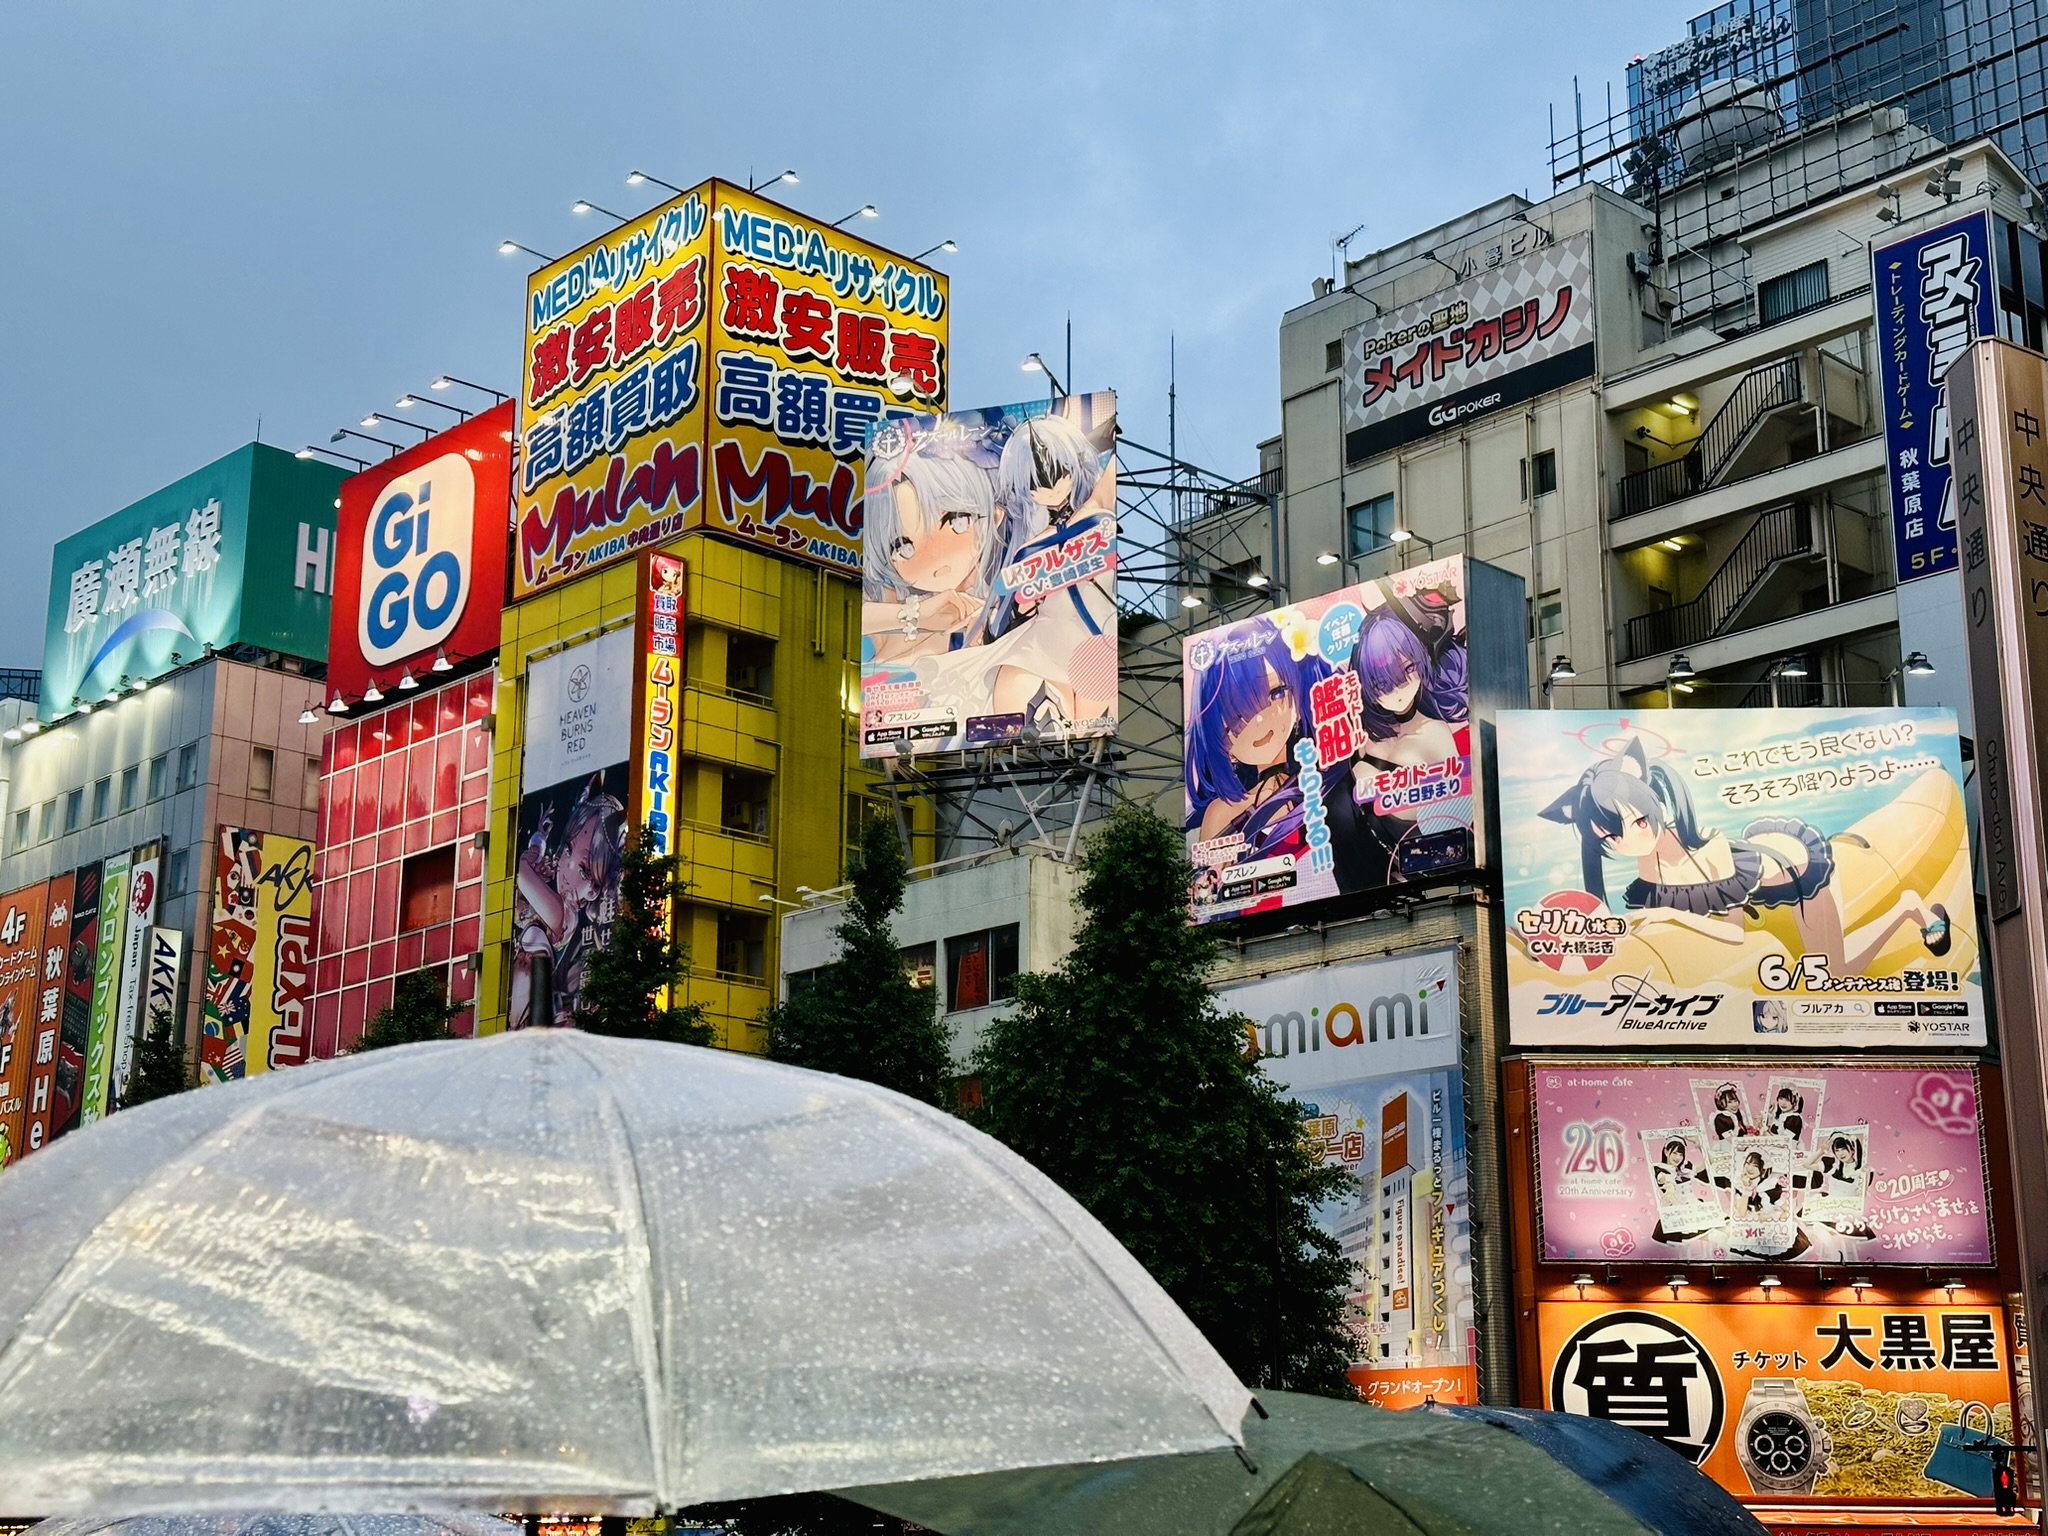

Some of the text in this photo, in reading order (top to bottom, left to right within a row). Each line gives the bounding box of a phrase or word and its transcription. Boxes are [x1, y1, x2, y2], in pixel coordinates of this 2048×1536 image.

[721, 205, 943, 319] MEDIAリサイクル
[530, 259, 702, 404] 激安販売
[723, 264, 942, 397] 激安販売
[1363, 300, 1469, 360] Pokerの聖地
[1363, 286, 1573, 408] メイドカジノ
[1891, 274, 1912, 420] トレーディングカードゲーム
[524, 341, 699, 492] 高額買取
[520, 442, 702, 583] Mulan
[1899, 447, 1924, 540] 秋葉原店
[2014, 407, 2048, 618] 中央通り
[373, 481, 431, 569] Gi
[1957, 417, 1986, 628] 中央通り
[293, 521, 337, 597] H
[587, 536, 626, 564] AKIBA
[1023, 531, 1109, 579] アルザス
[366, 550, 461, 650] GO
[654, 595, 677, 612] 買取
[654, 615, 677, 633] 販売
[1324, 611, 1356, 632] イベント
[653, 636, 677, 654] 市場
[560, 703, 597, 726] HEAVEN
[561, 719, 593, 741] BURNS
[888, 712, 921, 722] アズレン
[1312, 676, 1353, 766] 艦船
[567, 737, 586, 754] RED
[1374, 756, 1462, 792] モガドール
[1986, 739, 2004, 852] Chuo-dori
[1225, 865, 1257, 881] アズレン
[1, 906, 26, 945] 4F
[1758, 955, 1830, 992] 6/5
[1903, 970, 1960, 992] 登場!
[1537, 993, 1724, 1017] ブルーアーカイブ
[1800, 1003, 1844, 1014] ブルアカ
[1931, 1003, 1952, 1011] Google
[1922, 1022, 1970, 1032] YOSTAR
[1567, 1078, 1609, 1087] at-home
[1304, 1118, 1336, 1140] 葉原
[1564, 1123, 1625, 1175] 20
[1559, 1187, 1634, 1197] 20th Anniversary
[1732, 1350, 1808, 1371] チケット
[1816, 1312, 2000, 1372] 大黒屋
